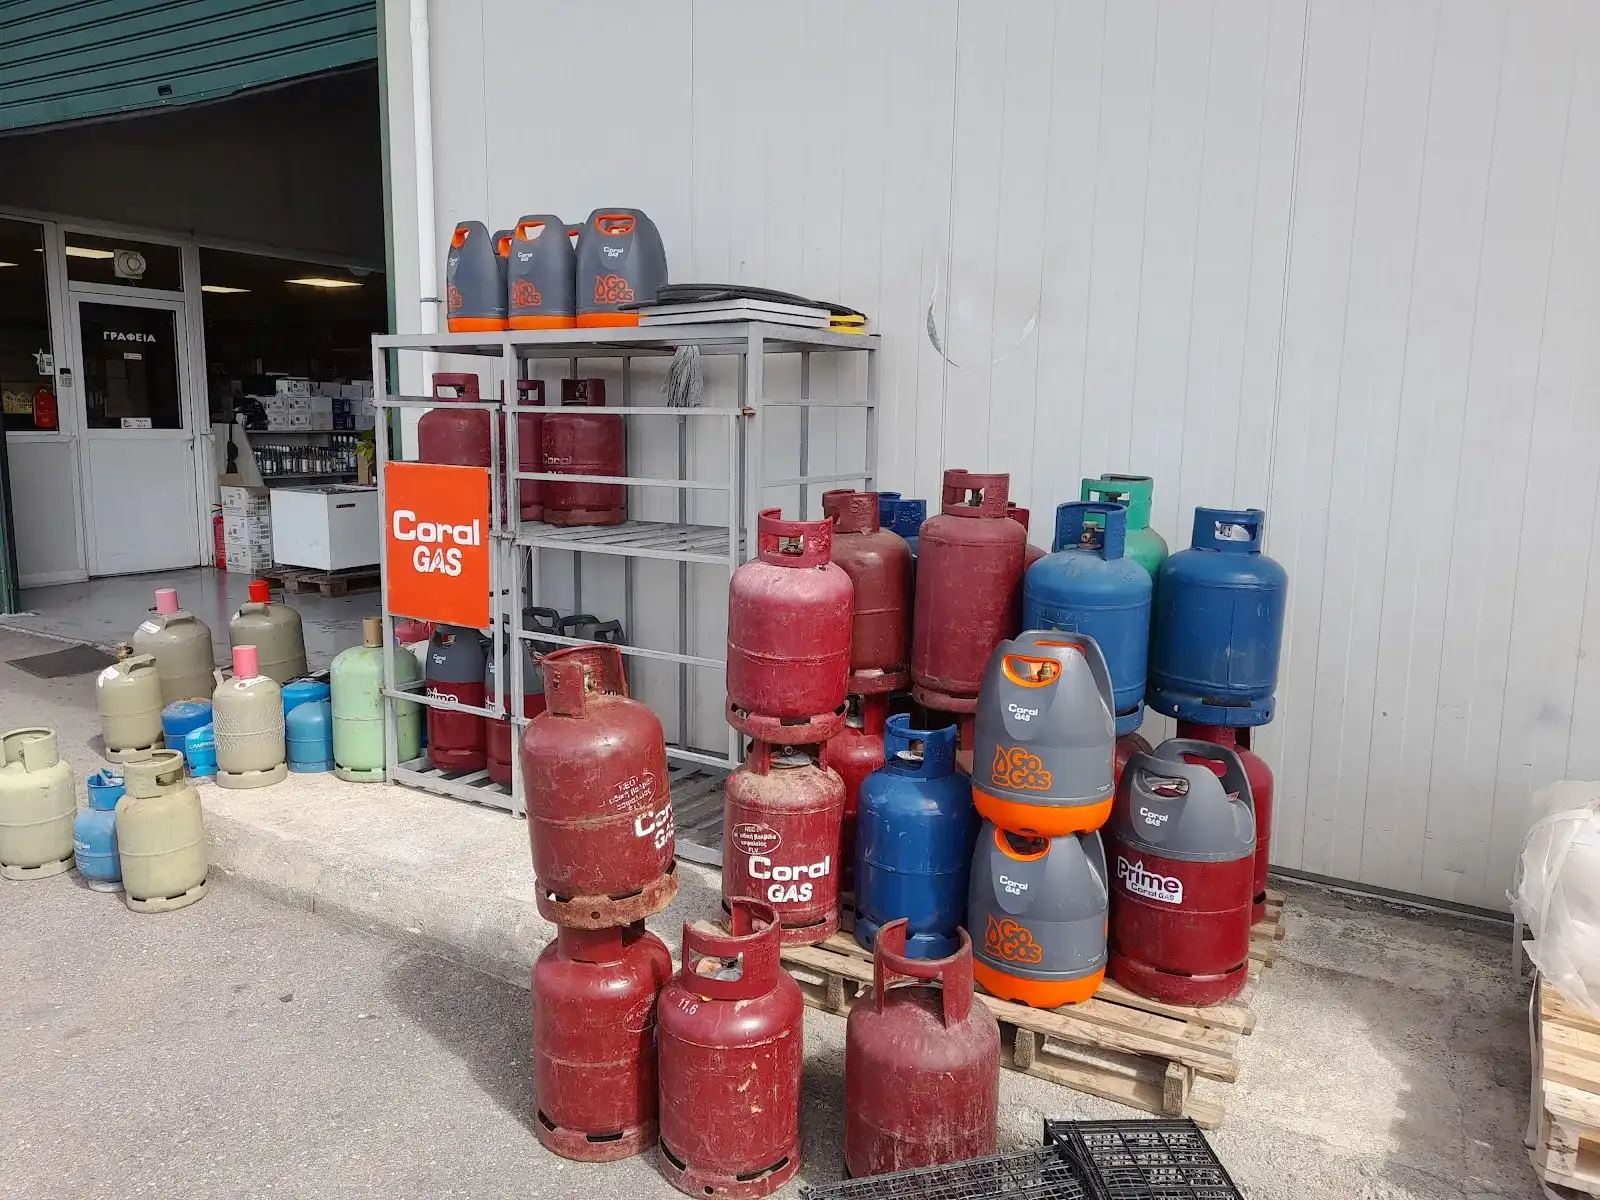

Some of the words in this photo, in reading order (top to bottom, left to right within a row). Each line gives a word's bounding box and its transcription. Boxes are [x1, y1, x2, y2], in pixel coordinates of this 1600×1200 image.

[603, 246, 624, 254] Coral
[606, 274, 627, 291] Go
[103, 331, 156, 343] ΓΡΑΦΕΙΑ
[392, 509, 481, 546] Coral
[412, 545, 463, 577] GAS
[1008, 703, 1039, 717] Coral
[1014, 712, 1031, 722] GAS
[189, 741, 216, 749] CAMPIN
[1008, 747, 1042, 772] Go
[1008, 767, 1052, 790] Gas
[1139, 807, 1169, 822] Coral
[1145, 816, 1161, 827] GAS
[748, 855, 830, 881] Coral
[1119, 858, 1180, 894] Prime
[999, 875, 1029, 891] Coral
[1005, 885, 1021, 896] GAS
[1131, 882, 1157, 897] Coral
[1158, 892, 1175, 901] GAS
[767, 882, 814, 903] GAS
[1000, 918, 1034, 943] Go
[1001, 939, 1043, 964] Gas
[678, 998, 699, 1015] 11,6
